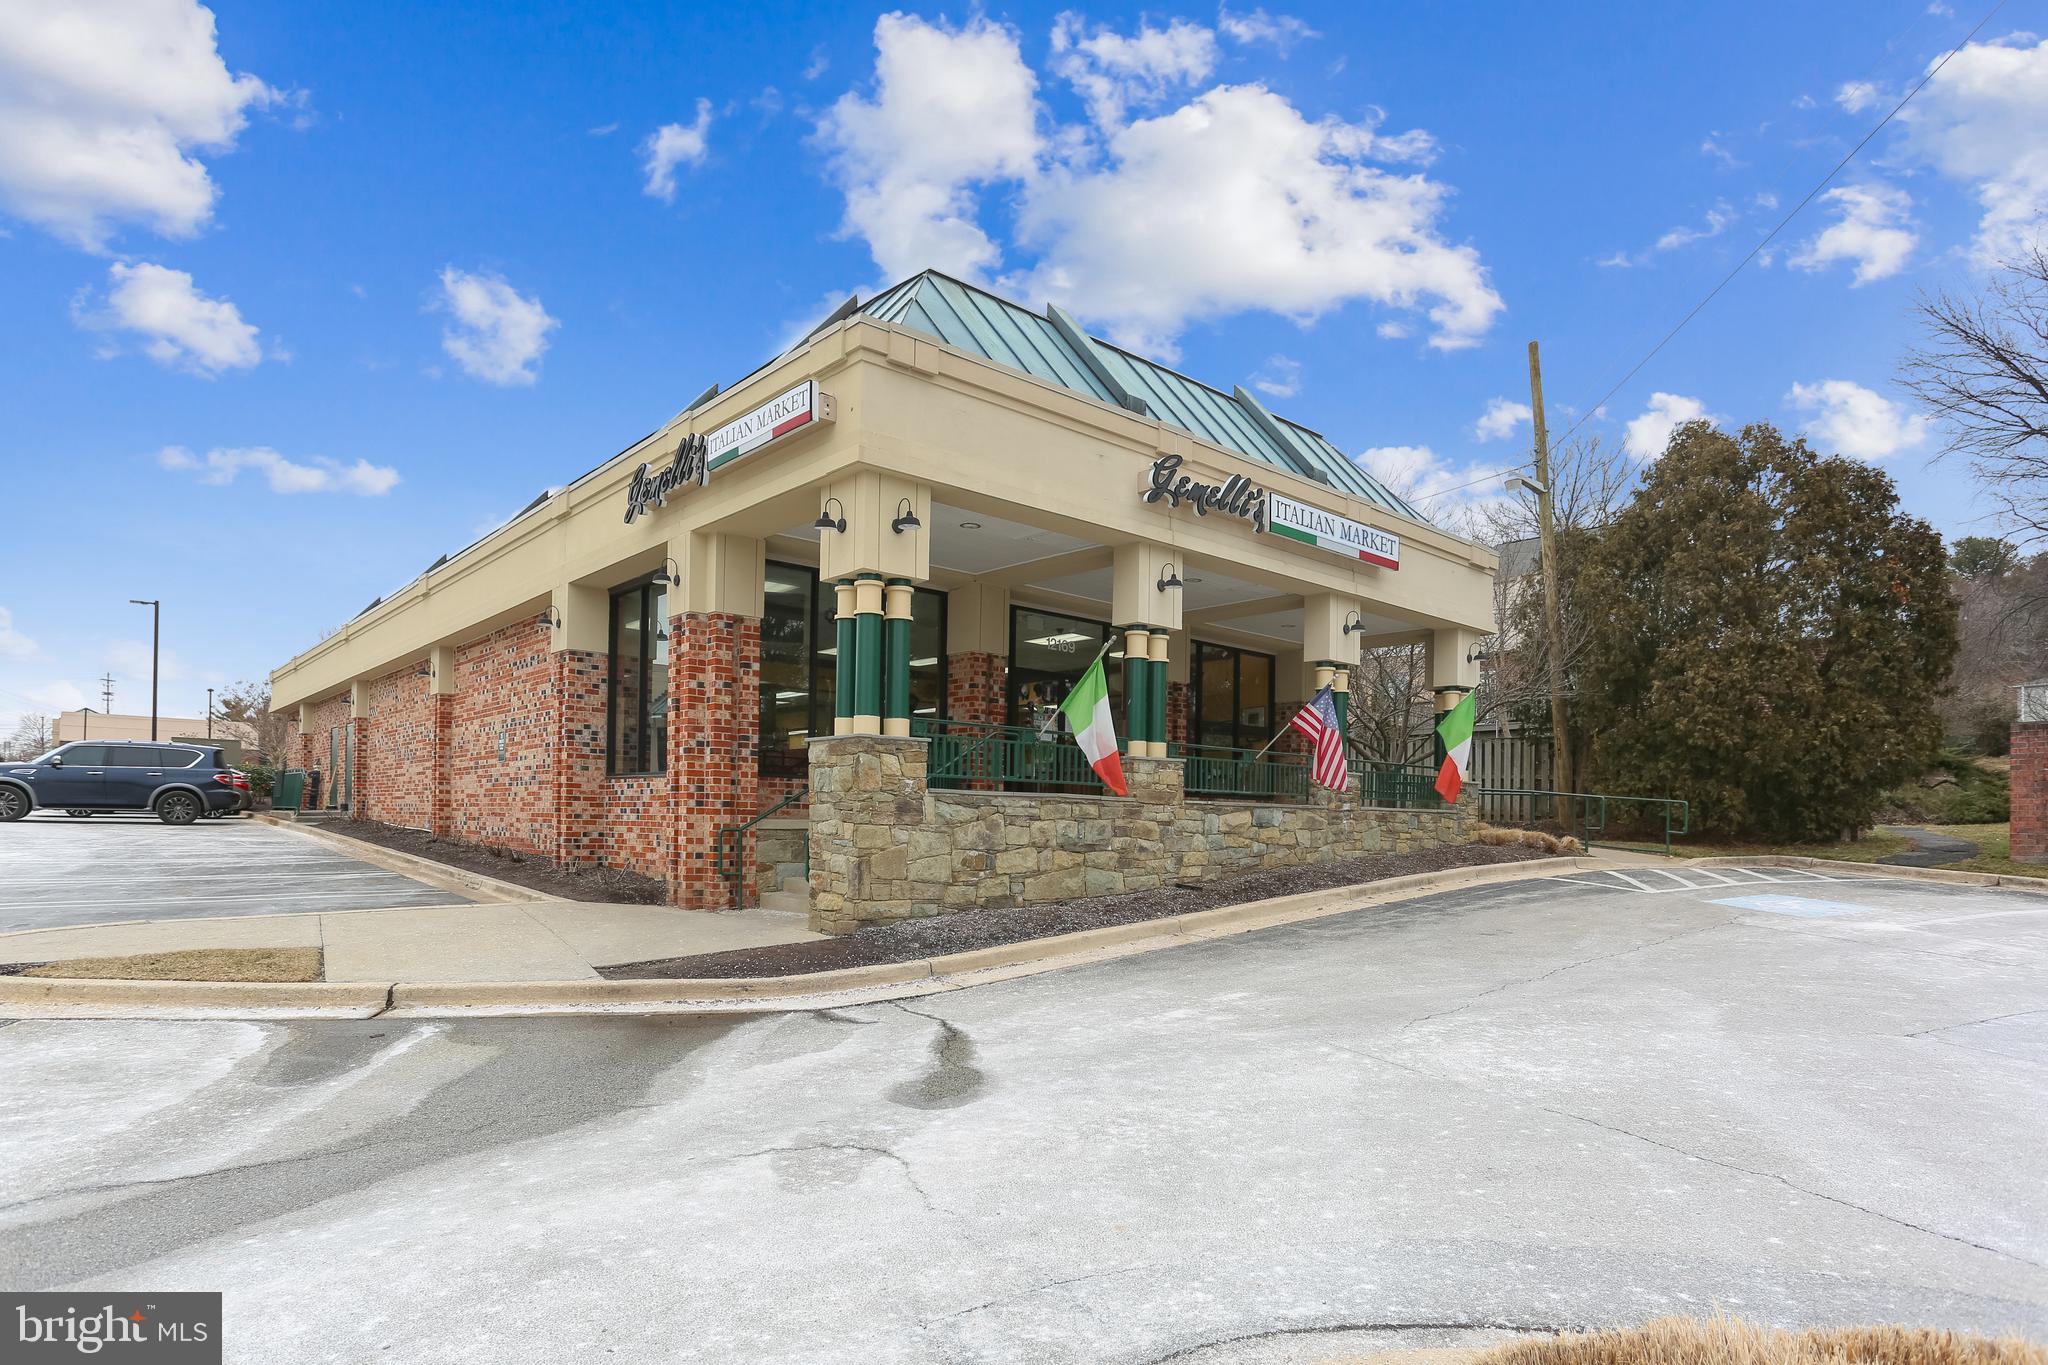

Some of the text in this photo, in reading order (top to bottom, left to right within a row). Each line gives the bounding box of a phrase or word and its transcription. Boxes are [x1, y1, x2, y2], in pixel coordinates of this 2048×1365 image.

[624, 388, 809, 524] Gemelli's ITALIAN MARKET
[1143, 454, 1397, 557] Gemelli's ITALIAN MARKET
[1046, 637, 1076, 653] 12169
